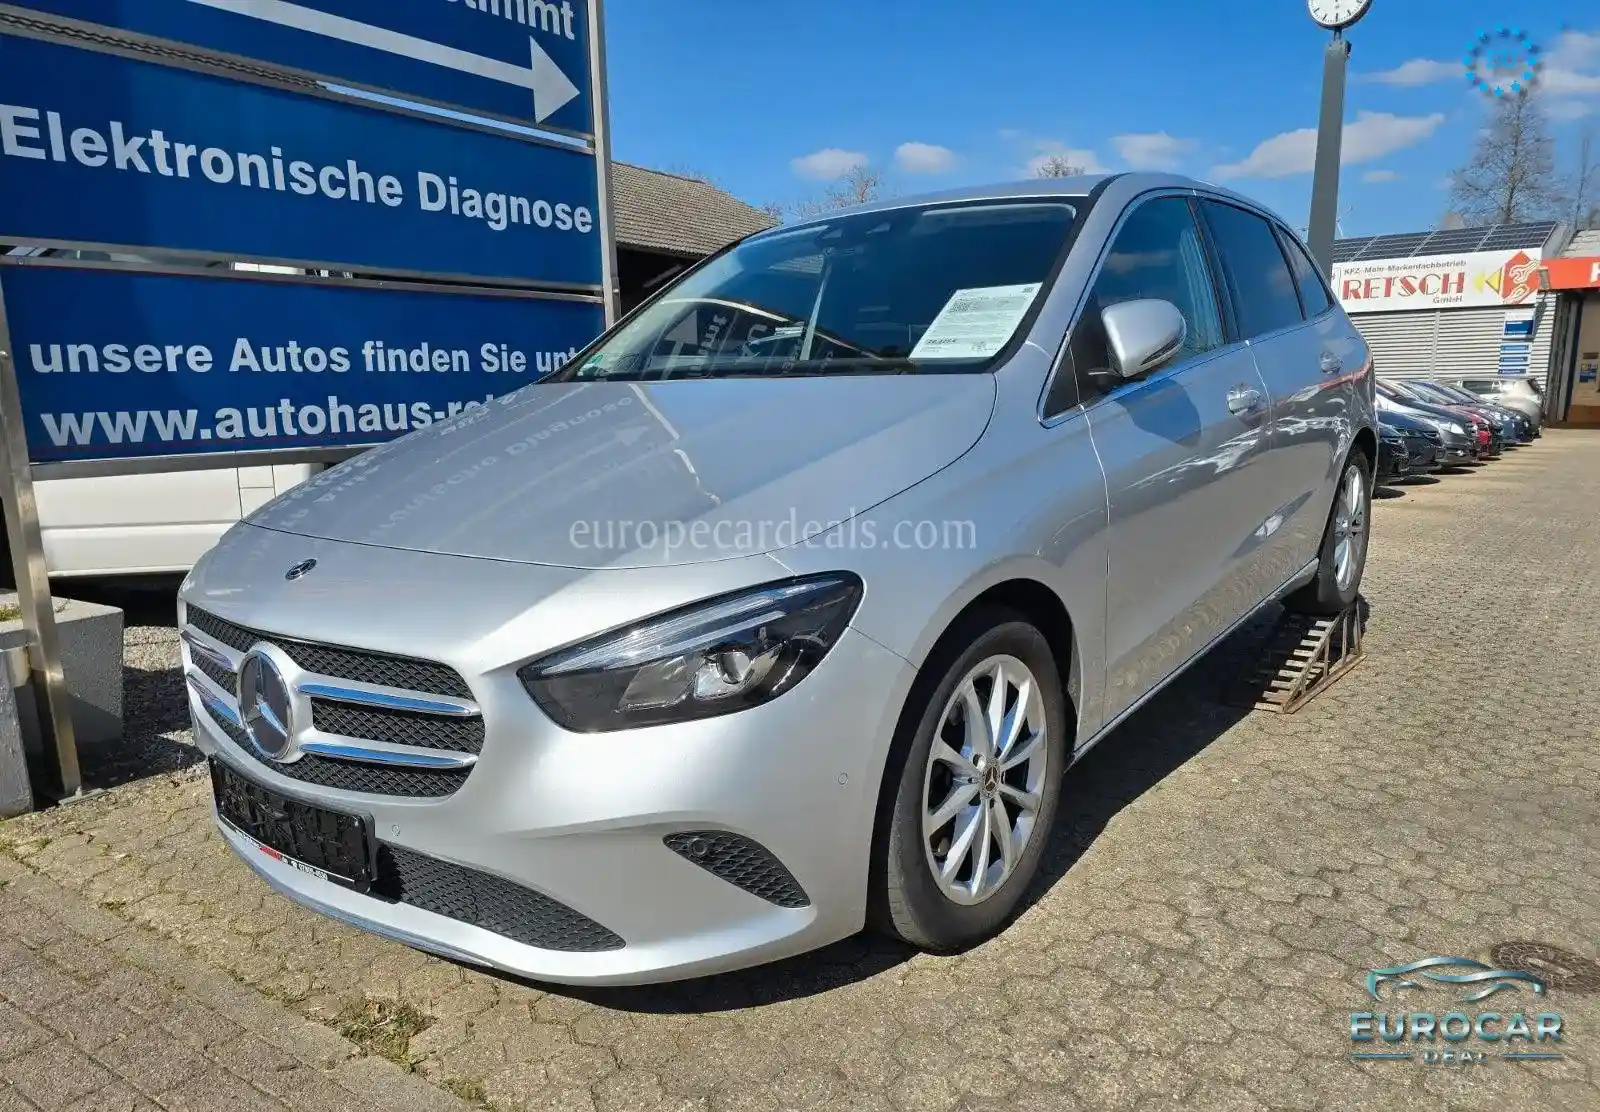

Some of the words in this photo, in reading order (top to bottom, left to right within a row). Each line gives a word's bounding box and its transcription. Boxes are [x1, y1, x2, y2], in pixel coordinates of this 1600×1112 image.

[0, 104, 403, 207] Elektronische
[418, 171, 592, 233] Diagnose
[1342, 272, 1465, 300] RETSCH
[30, 343, 213, 373] unsere
[229, 338, 350, 372] Autos
[361, 341, 470, 372] finden
[480, 342, 527, 372] Sie
